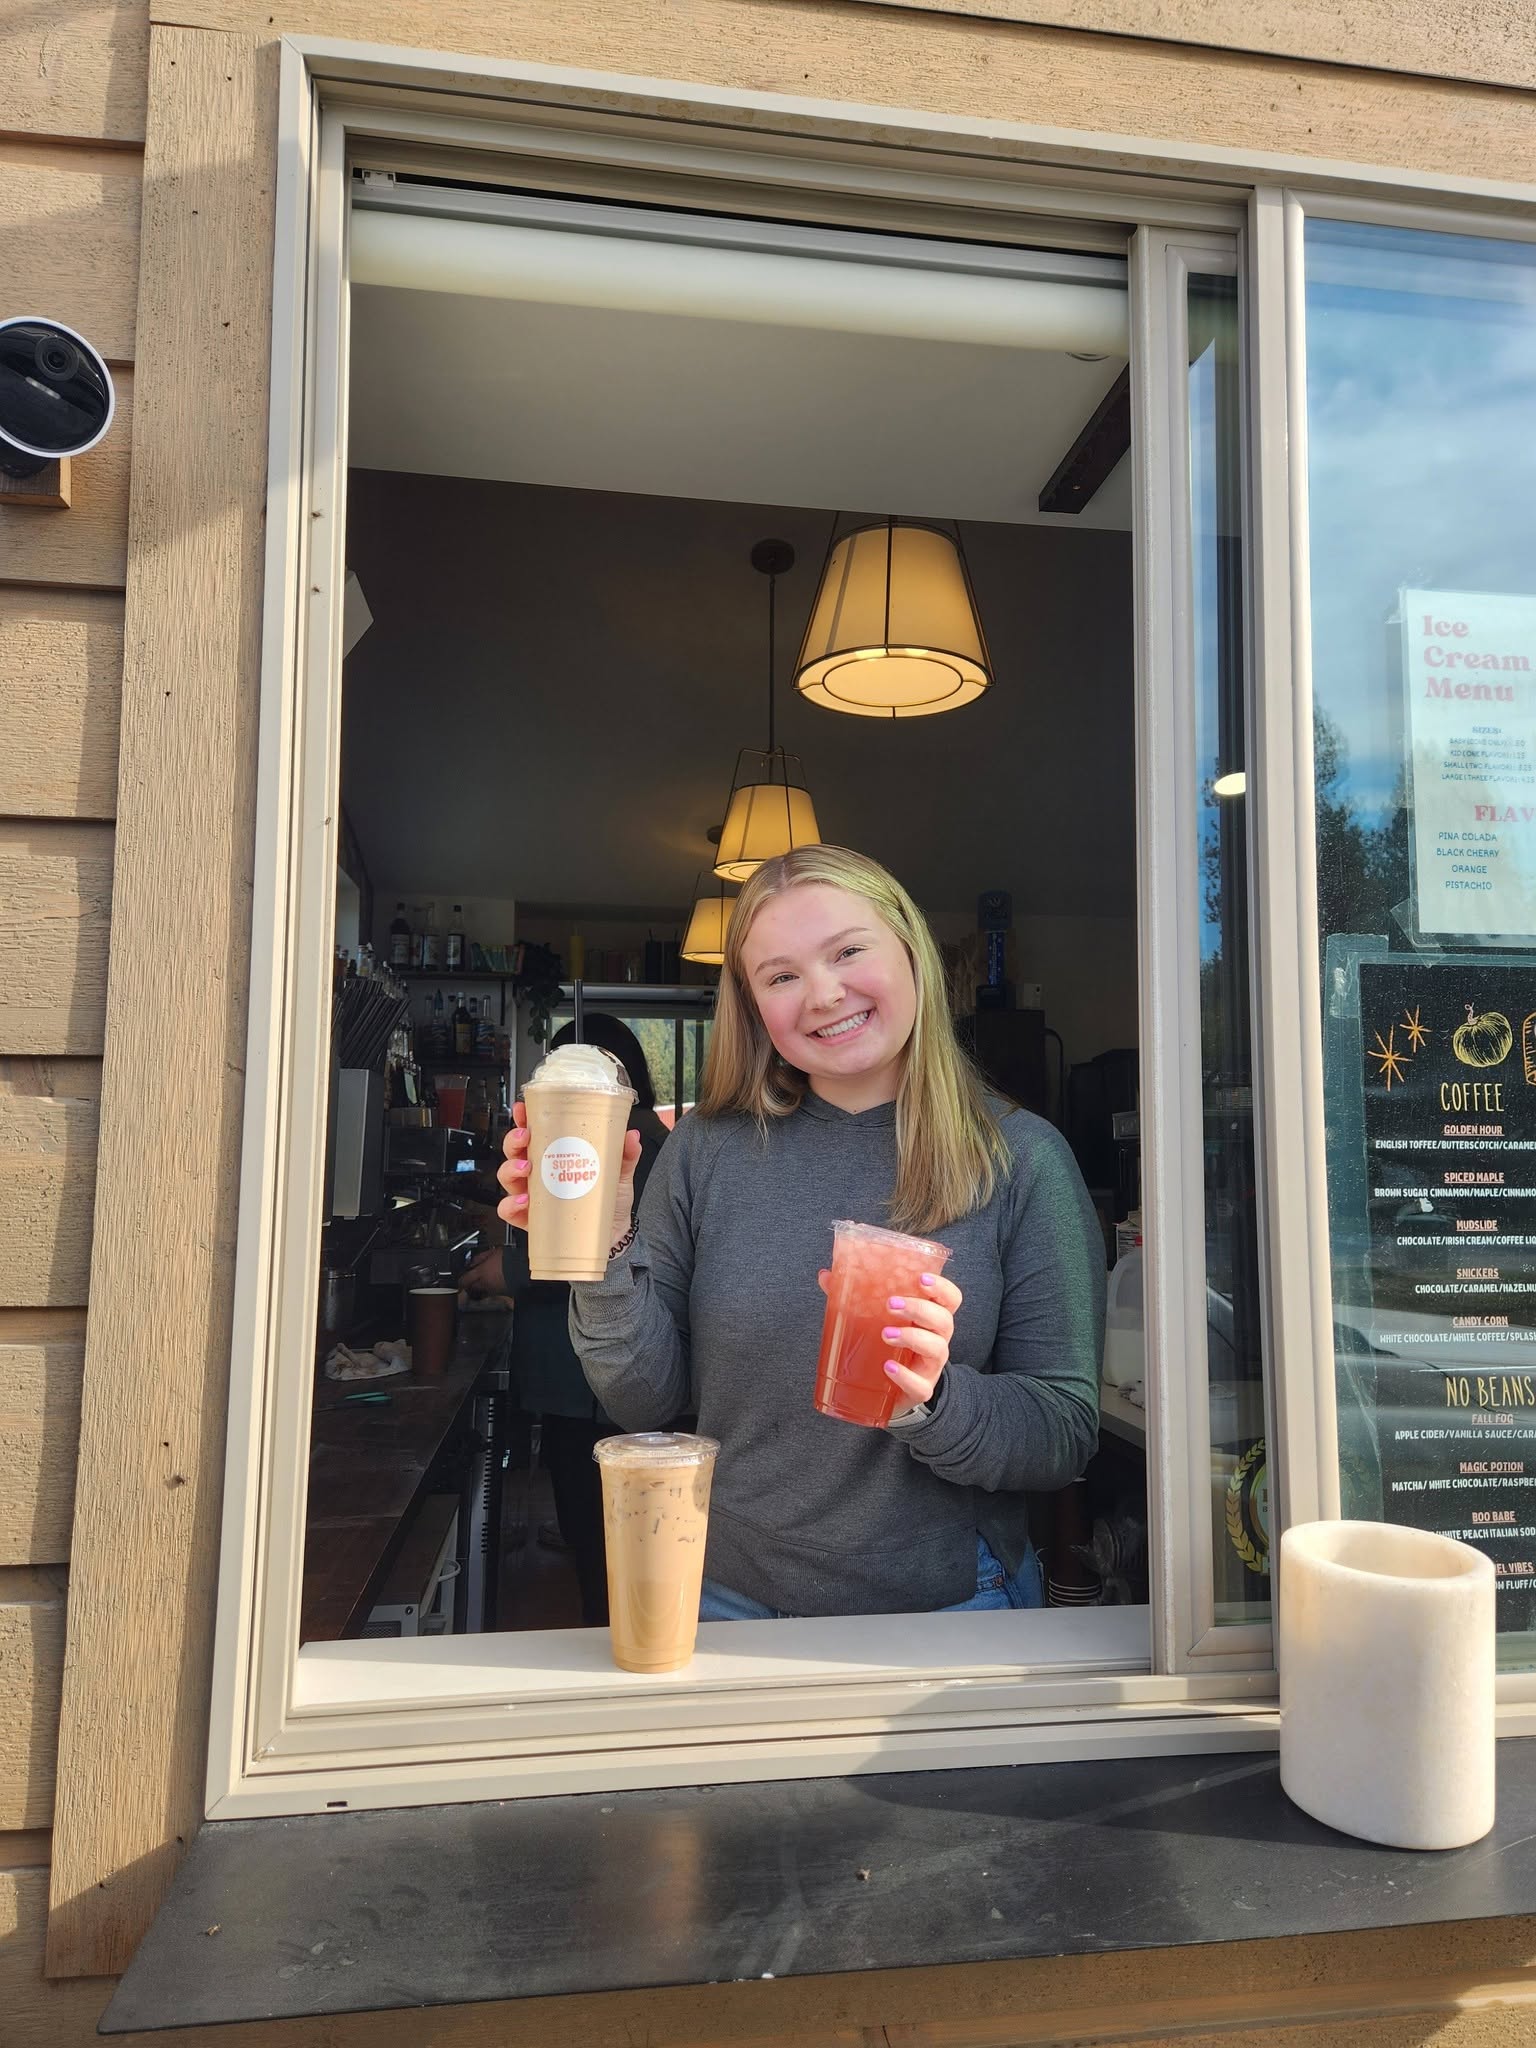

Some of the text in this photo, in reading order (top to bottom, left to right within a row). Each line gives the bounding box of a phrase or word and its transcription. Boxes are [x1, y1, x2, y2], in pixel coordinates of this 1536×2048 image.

[1423, 615, 1469, 637] Ice
[1424, 646, 1531, 671] Cream
[1424, 677, 1514, 702] Menu
[1475, 805, 1536, 822] FLAV
[1438, 832, 1498, 842] PINA COLADA
[1436, 847, 1500, 858] BLACK CHERRY
[1451, 864, 1488, 874] ORANGE
[1445, 880, 1493, 890] PISTACHIO
[1440, 1082, 1505, 1112] COFFEE
[1443, 1125, 1503, 1135] GOLDEN HOUR
[1375, 1140, 1408, 1150] ENGLISH
[552, 1158, 590, 1171] super
[558, 1170, 597, 1184] duper
[1444, 1172, 1504, 1182] SPICED MAPLE
[1374, 1188, 1536, 1198] BROWN SUGAR CINNAMON/MAPLE/CINNAMO
[1456, 1220, 1498, 1230] MUDSLIDE
[1397, 1236, 1465, 1246] CHOCOLATE/IRISH
[1466, 1235, 1524, 1245] CREAM/COFFEE
[1456, 1268, 1499, 1278] SNICKERS
[1415, 1283, 1536, 1294] CHOCOLATE/CARAMEL/HAZELNU
[1452, 1316, 1509, 1326] CANDY CORN
[1380, 1332, 1536, 1344] WHITE CHOCOLATE/WHITE COFFEE/SPLAS
[1446, 1376, 1535, 1407] NO BEANS
[1472, 1414, 1513, 1424] FALL FOG
[1395, 1430, 1419, 1440] APPLE
[1420, 1429, 1483, 1439] CIDER/VANILLA
[1460, 1462, 1524, 1472] MAGIC POTION
[1428, 1479, 1451, 1489] WHITE
[1472, 1511, 1516, 1522] BOO BABE
[1463, 1528, 1489, 1539] PEACH
[1489, 1527, 1518, 1538] ITALIAN
[1519, 1526, 1536, 1536] SOD
[1508, 1562, 1534, 1572] VIBES
[1505, 1579, 1536, 1590] FLUFF/C
